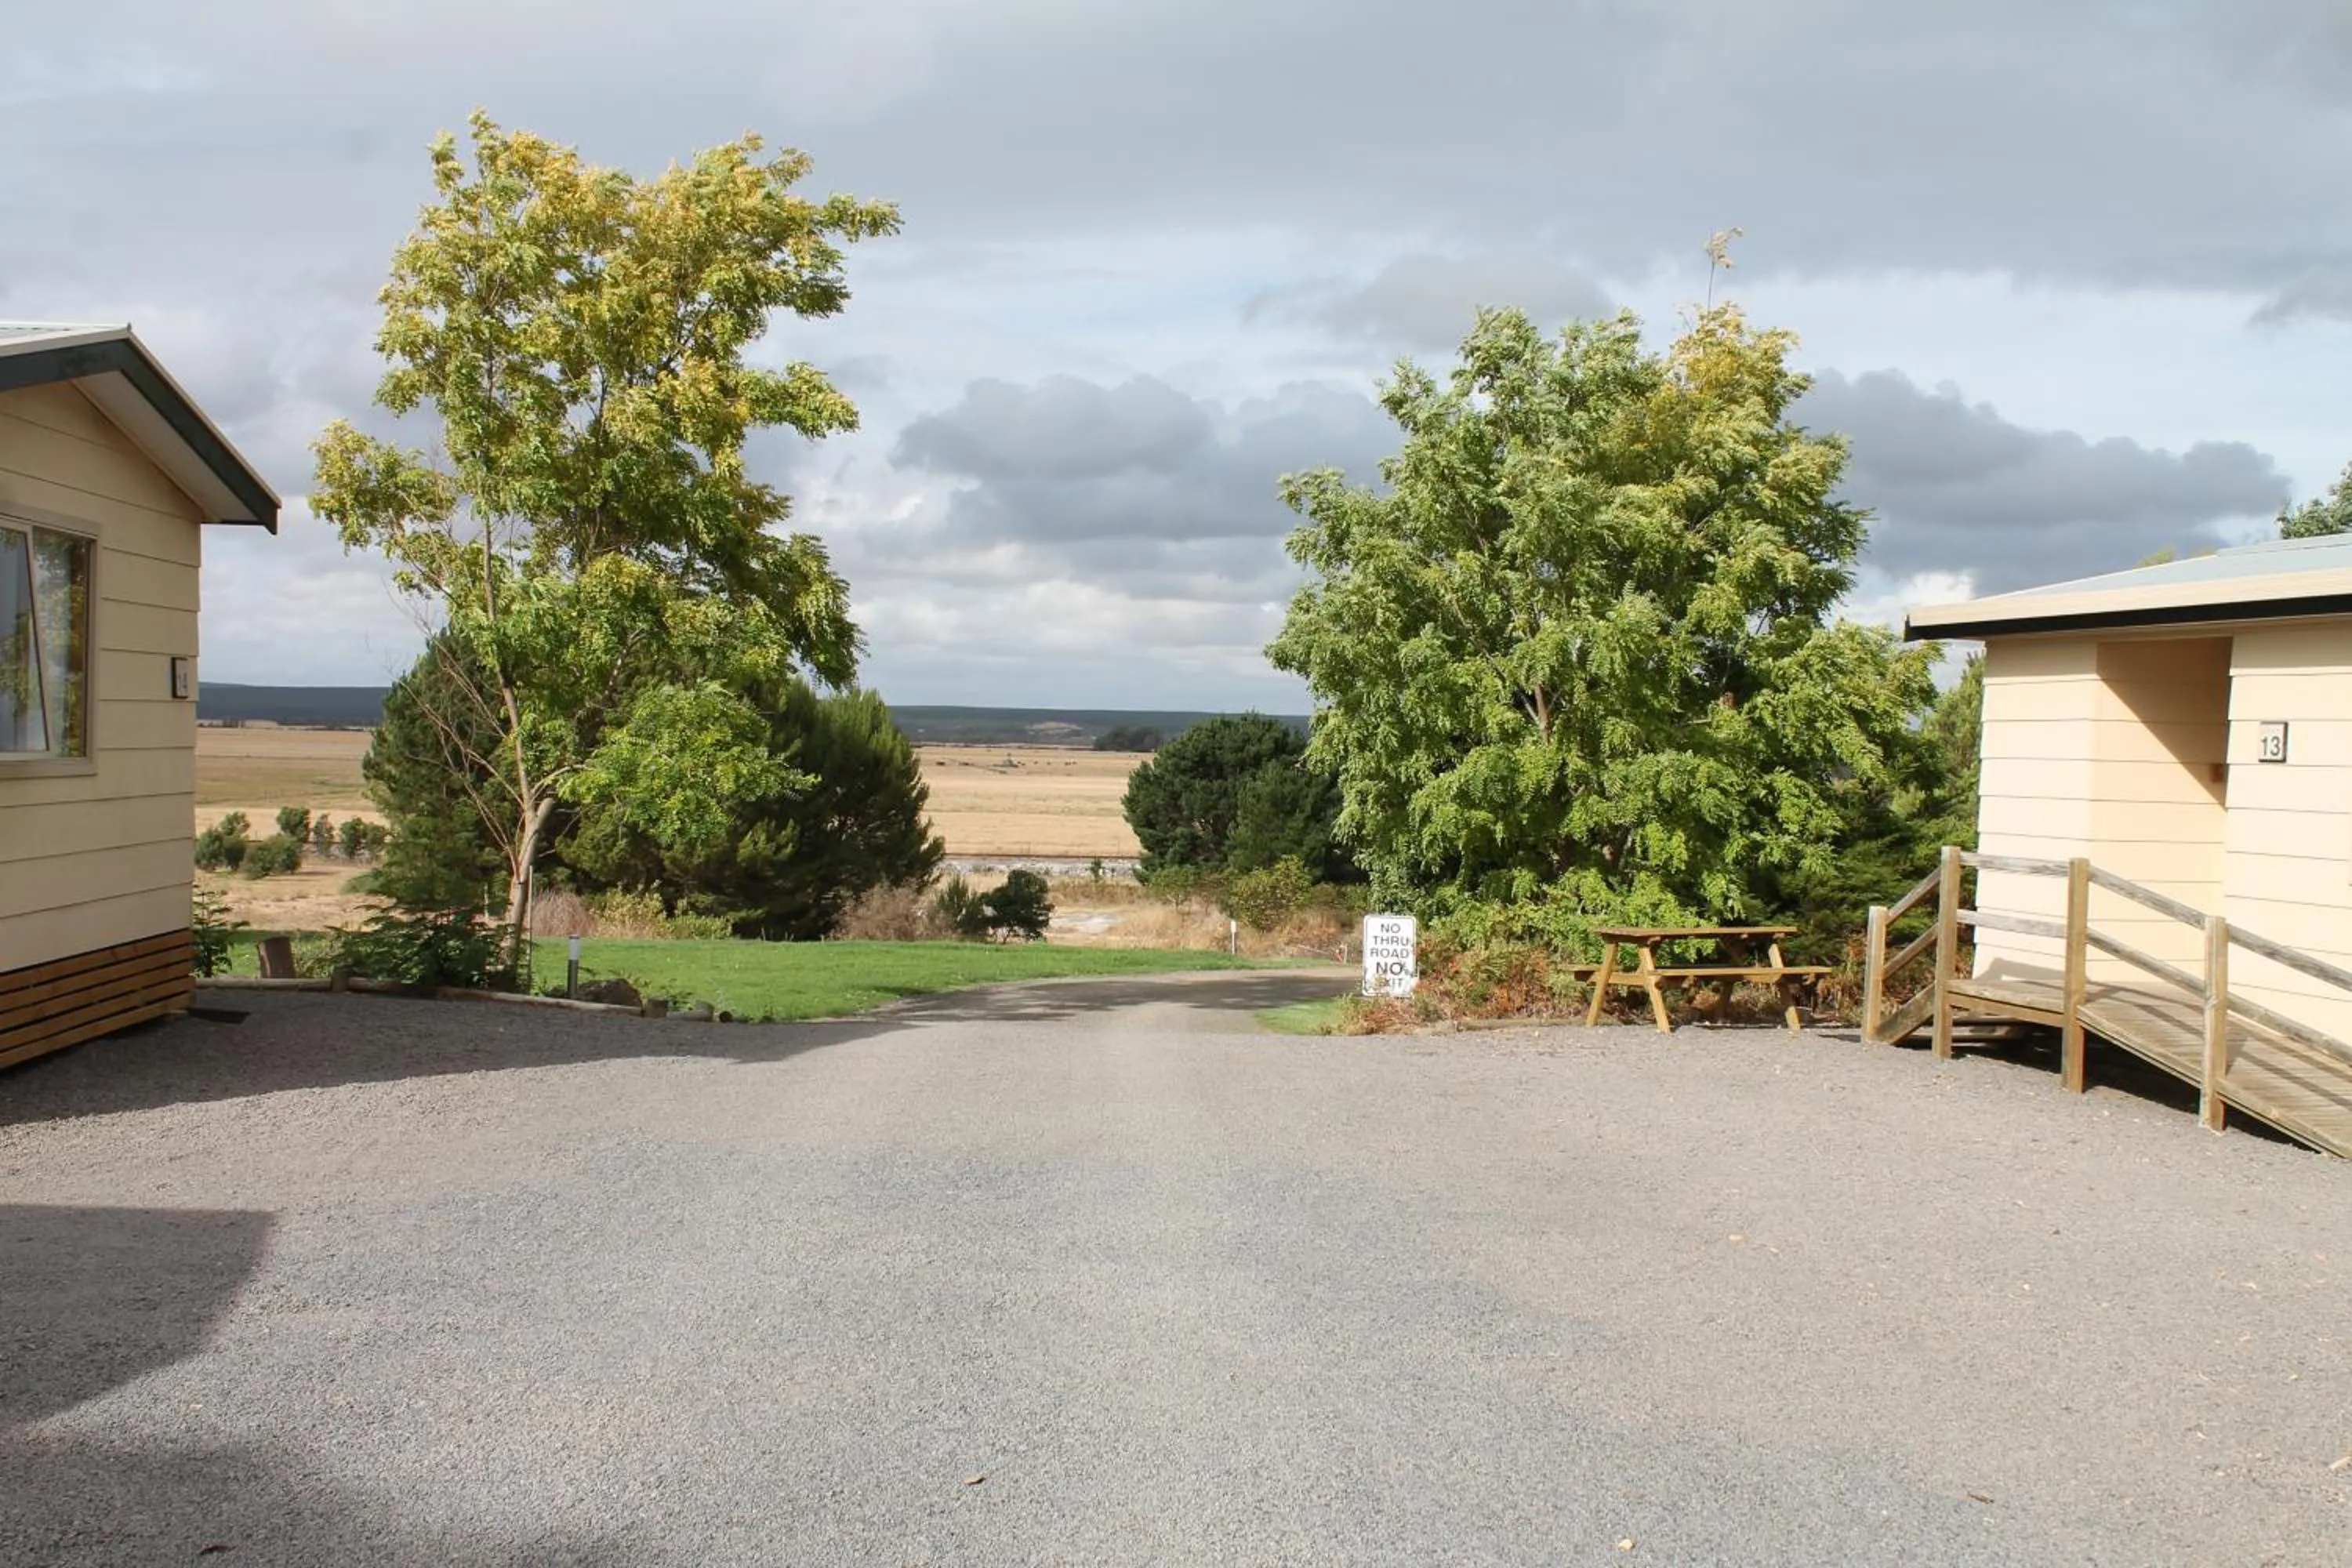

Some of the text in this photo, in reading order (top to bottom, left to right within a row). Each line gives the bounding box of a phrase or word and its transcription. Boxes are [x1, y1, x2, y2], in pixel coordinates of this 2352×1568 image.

[2260, 735, 2281, 757] 13
[1381, 923, 1401, 934] NO
[1373, 935, 1409, 946] THRU
[1370, 947, 1409, 959] ROAD
[1376, 961, 1403, 976] NO
[1375, 978, 1403, 988] XIT
